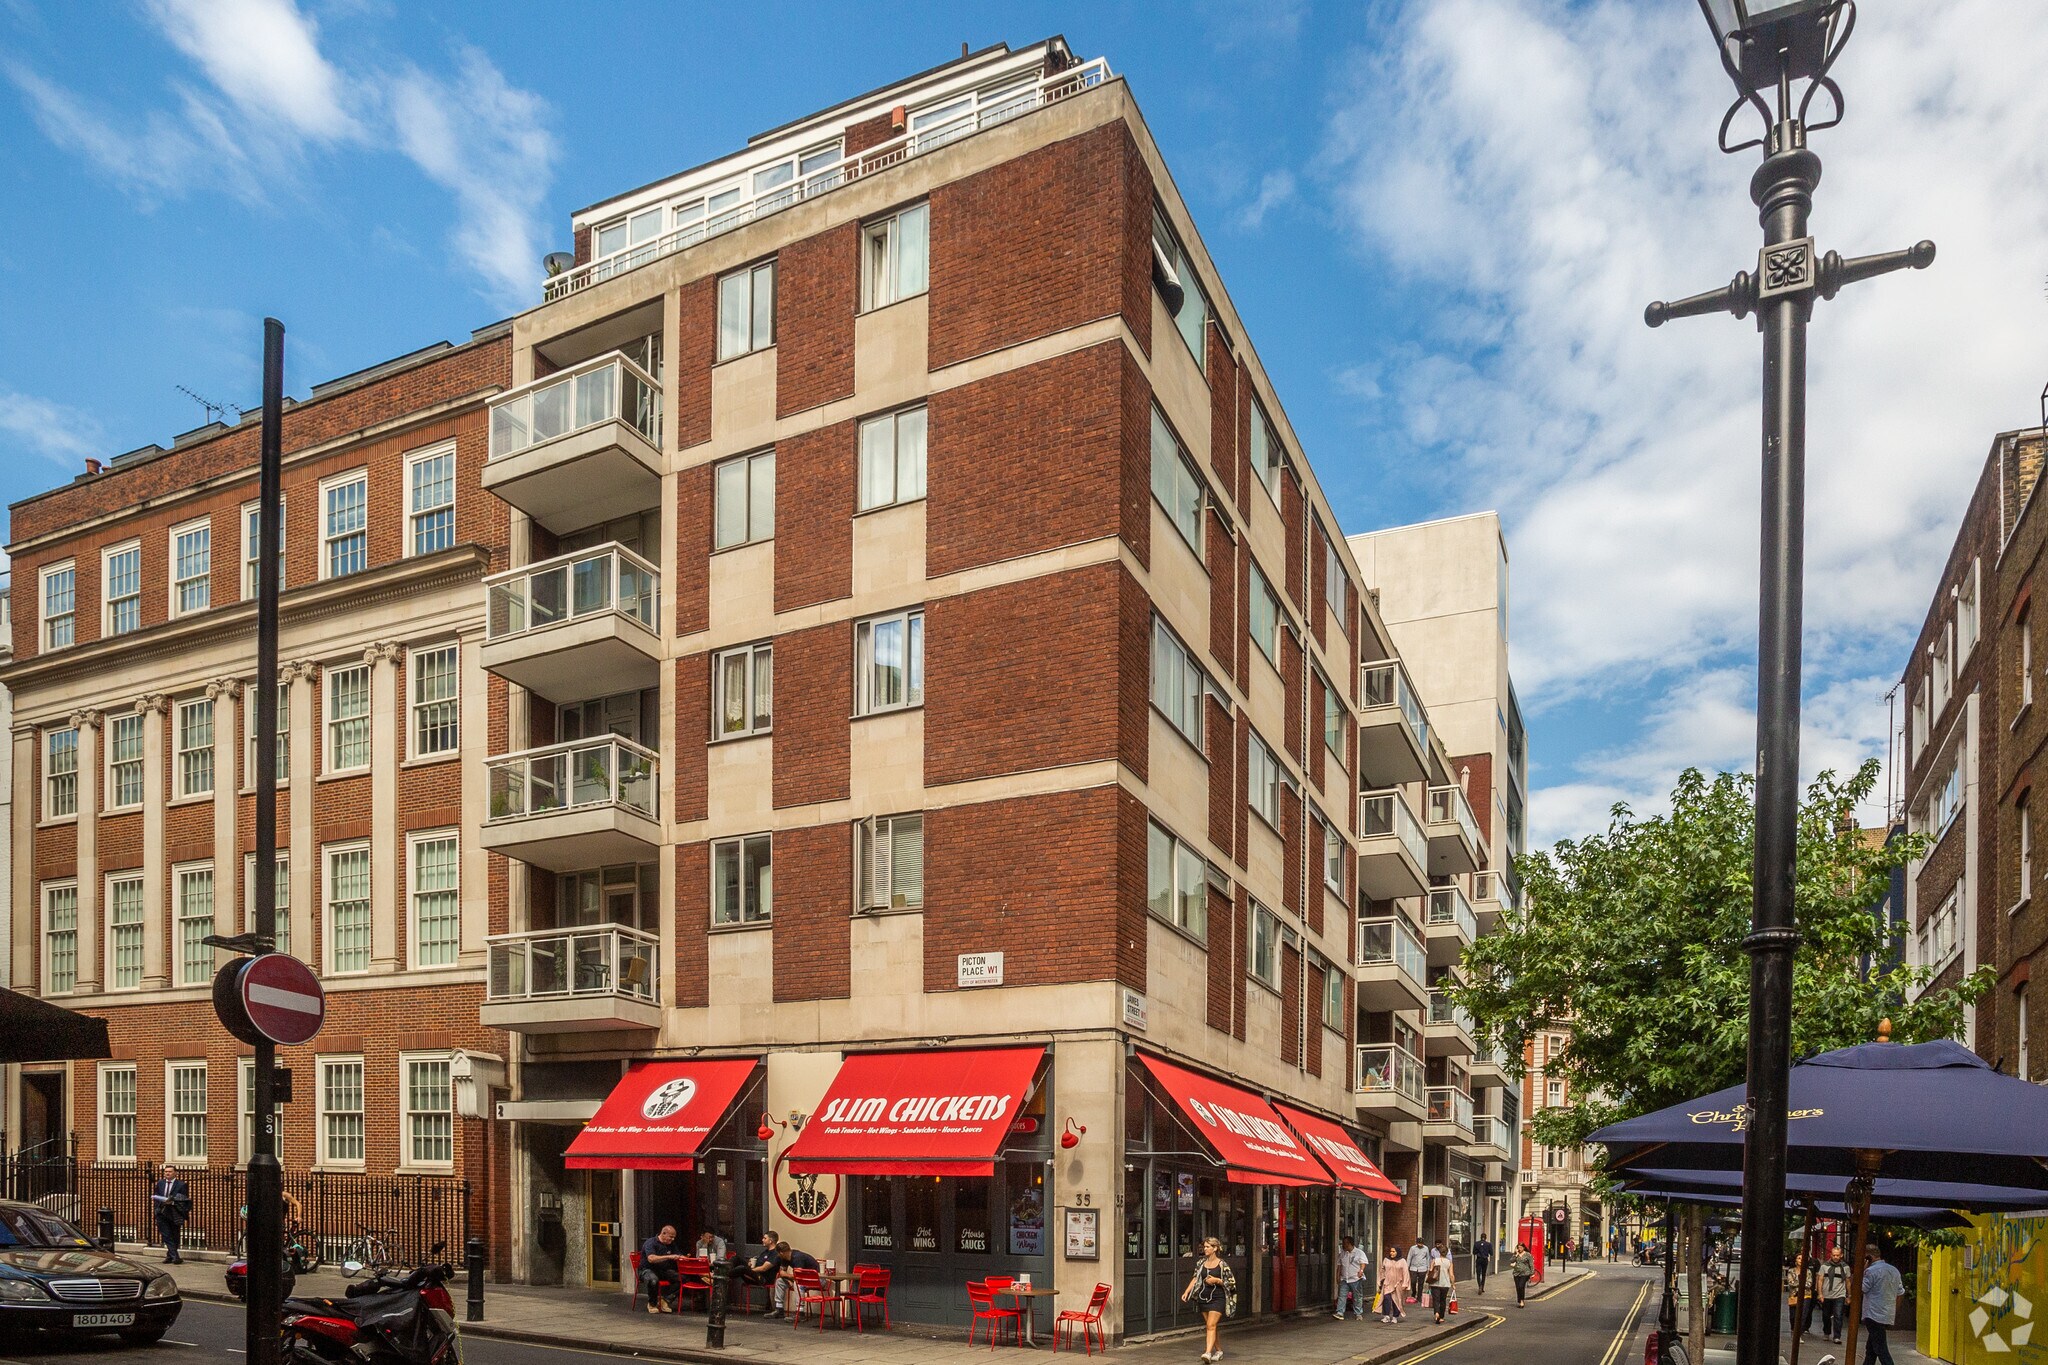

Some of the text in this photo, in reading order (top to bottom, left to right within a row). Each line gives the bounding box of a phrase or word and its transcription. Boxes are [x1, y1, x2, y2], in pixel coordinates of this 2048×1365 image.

[962, 956, 986, 966] PICTON
[962, 965, 998, 976] PLACE W1
[1127, 1004, 1140, 1017] STREET
[820, 1095, 1012, 1122] SLIM CHICKENS
[866, 1126, 879, 1134] Hot
[878, 1126, 898, 1135] Wings
[902, 1126, 937, 1134] Sandwiches
[941, 1125, 961, 1133] House
[961, 1125, 983, 1133] Sauces
[1075, 1193, 1091, 1207] 35
[868, 1224, 888, 1235] Fresh
[916, 1226, 932, 1237] Hot
[961, 1228, 985, 1239] House
[864, 1235, 892, 1247] TENDERS
[913, 1237, 936, 1248] WINGS
[961, 1239, 986, 1250] SAUCES
[77, 1314, 132, 1325] 180 D 403
